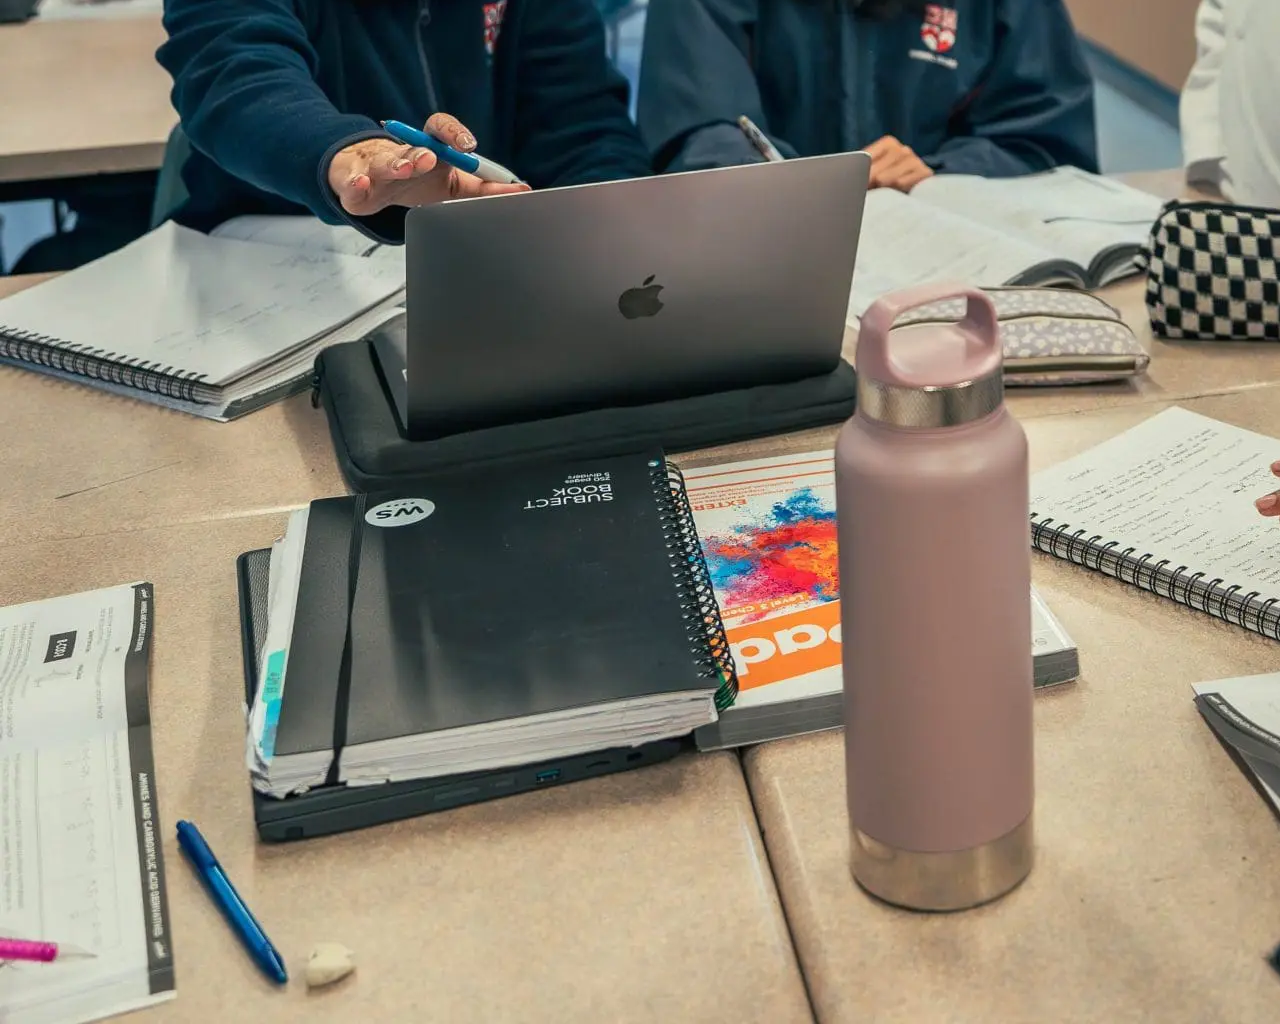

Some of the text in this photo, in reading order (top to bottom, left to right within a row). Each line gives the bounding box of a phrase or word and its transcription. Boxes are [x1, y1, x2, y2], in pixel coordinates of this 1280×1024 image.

[567, 472, 602, 480] dividers
[552, 483, 612, 497] BOOK
[523, 492, 614, 510] SUBJECT
[375, 505, 425, 520] WS
[771, 594, 806, 608] Level
[138, 772, 150, 802] AMINES
[142, 802, 152, 819] AND
[144, 820, 157, 871] CARBOXYLIC
[149, 871, 159, 890] ACID
[151, 890, 164, 938] DERIVATIVES
